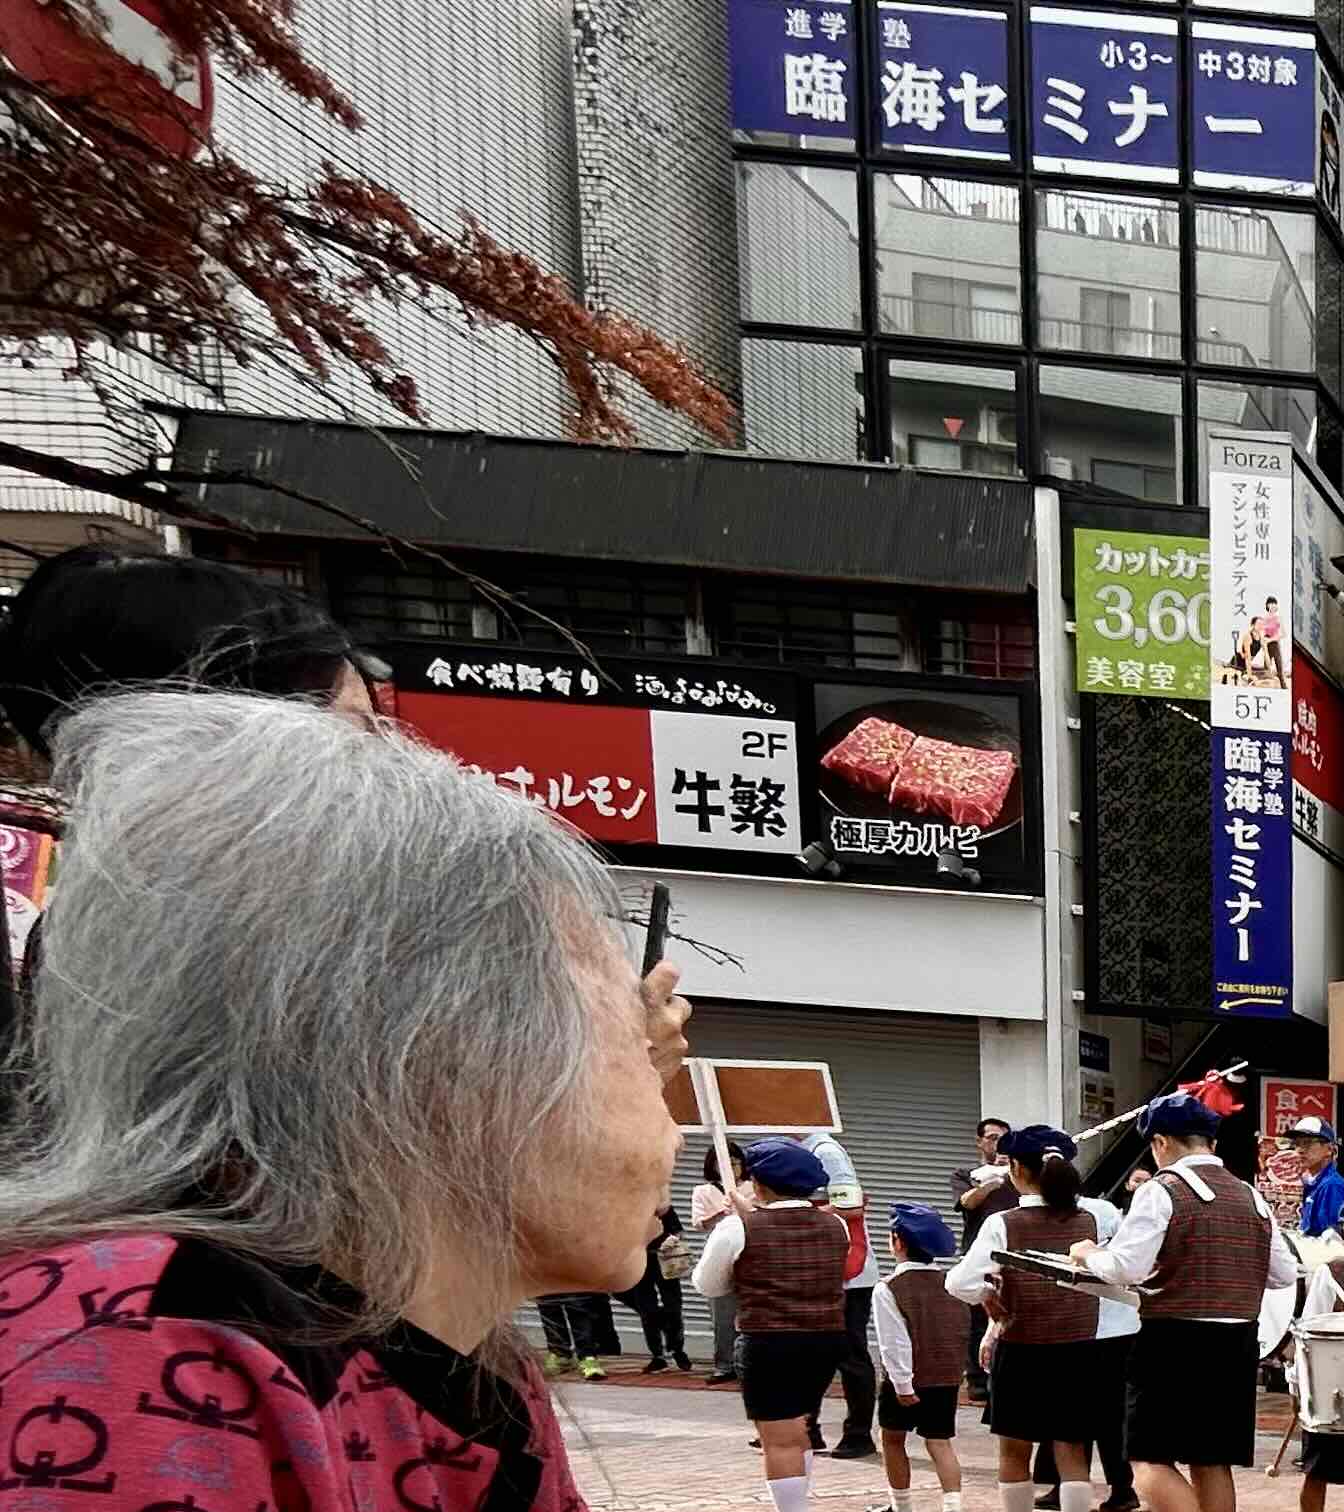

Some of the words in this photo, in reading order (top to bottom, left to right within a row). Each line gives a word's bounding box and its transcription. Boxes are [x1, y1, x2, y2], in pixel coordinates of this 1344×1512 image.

[786, 7, 912, 50] 進学塾
[783, 52, 1263, 147] 臨海セミナー
[1223, 446, 1281, 470] Forza
[1254, 480, 1271, 561] 女性専用
[1231, 482, 1248, 617] マシンピラティス
[426, 657, 599, 696] 食べ放題有り
[1086, 656, 1177, 690] 美容室
[1234, 695, 1272, 720] 5F
[742, 731, 788, 758] 2F
[458, 763, 648, 820] ホルモン
[1263, 741, 1285, 816] 進学塾
[671, 767, 788, 838] 牛繁
[830, 815, 981, 858] 極厚カルビ
[1224, 737, 1262, 962] 臨海セミナー
[1276, 1088, 1325, 1111] 食べ
